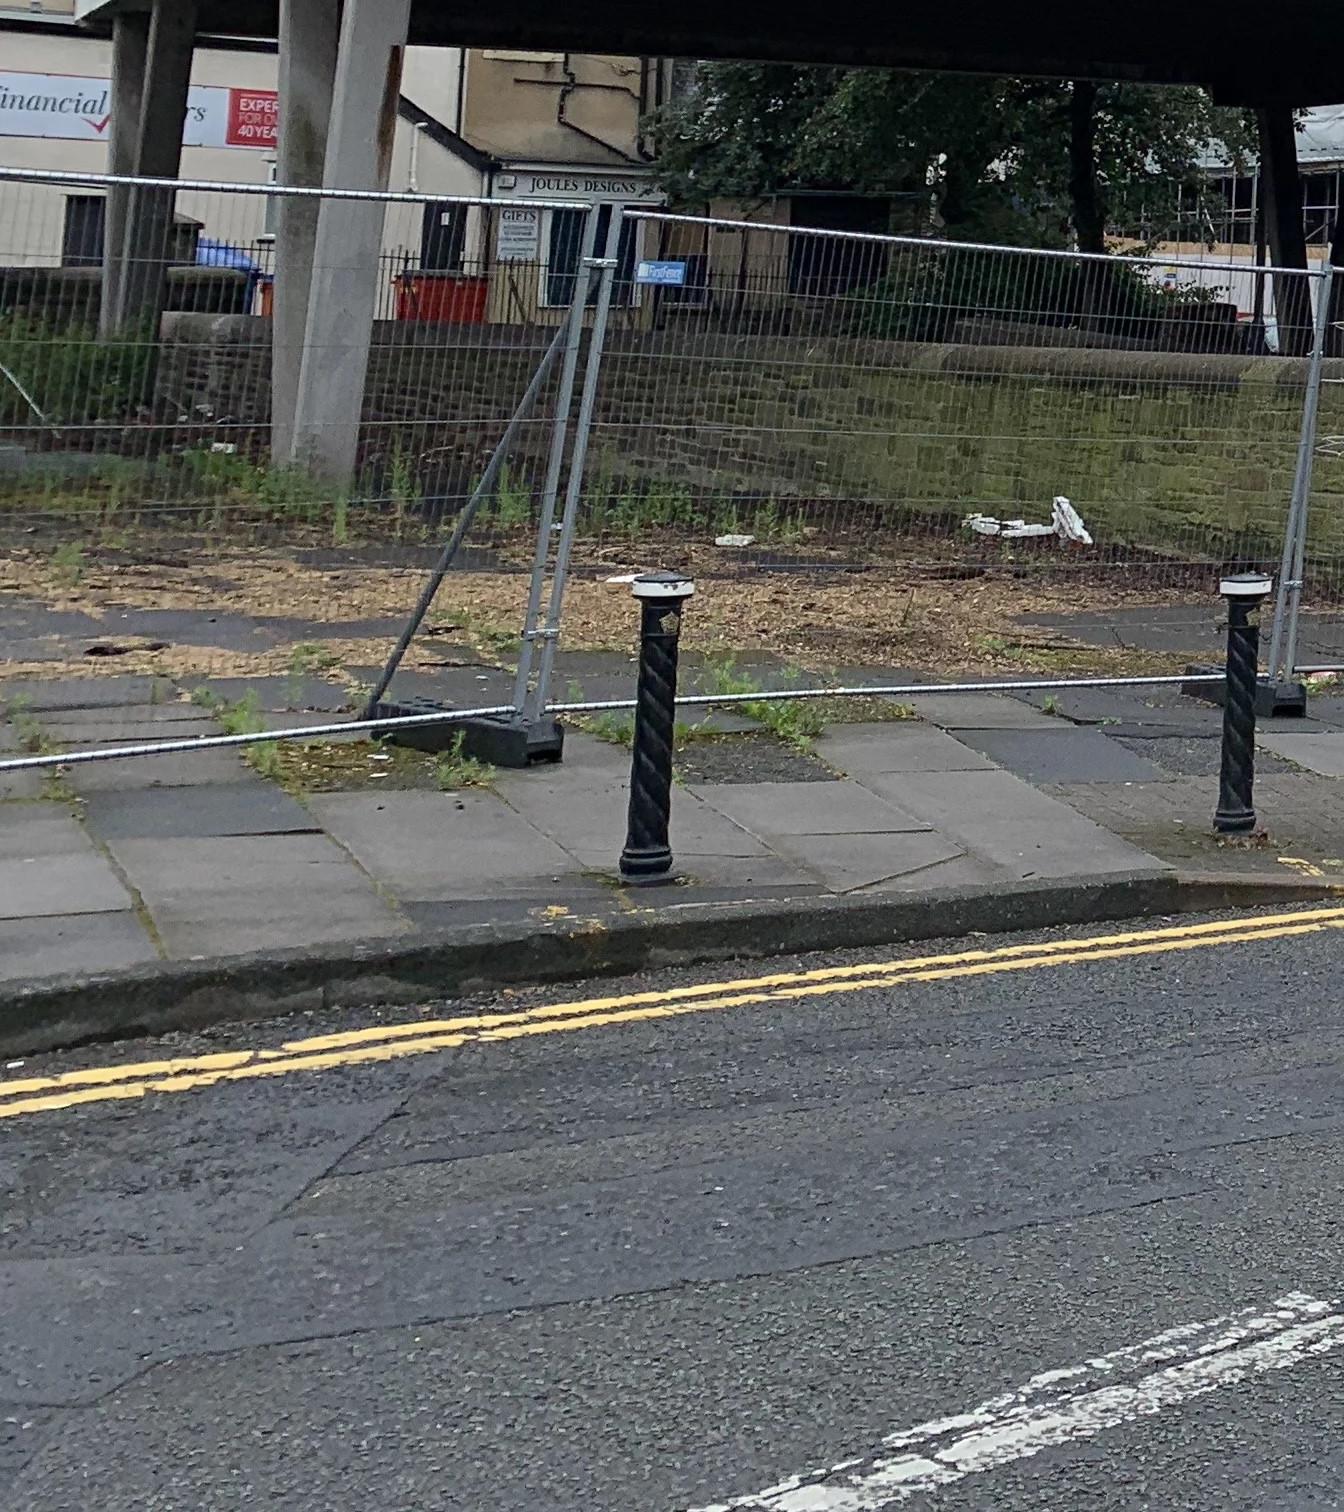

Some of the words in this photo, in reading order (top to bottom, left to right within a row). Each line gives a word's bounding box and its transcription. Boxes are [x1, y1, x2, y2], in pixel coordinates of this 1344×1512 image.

[0, 85, 108, 115] inancial
[239, 112, 261, 125] FOR
[237, 125, 254, 137] 40
[529, 178, 579, 193] JOULES
[583, 181, 637, 194] DESIGNS
[502, 210, 536, 222] GIFTS
